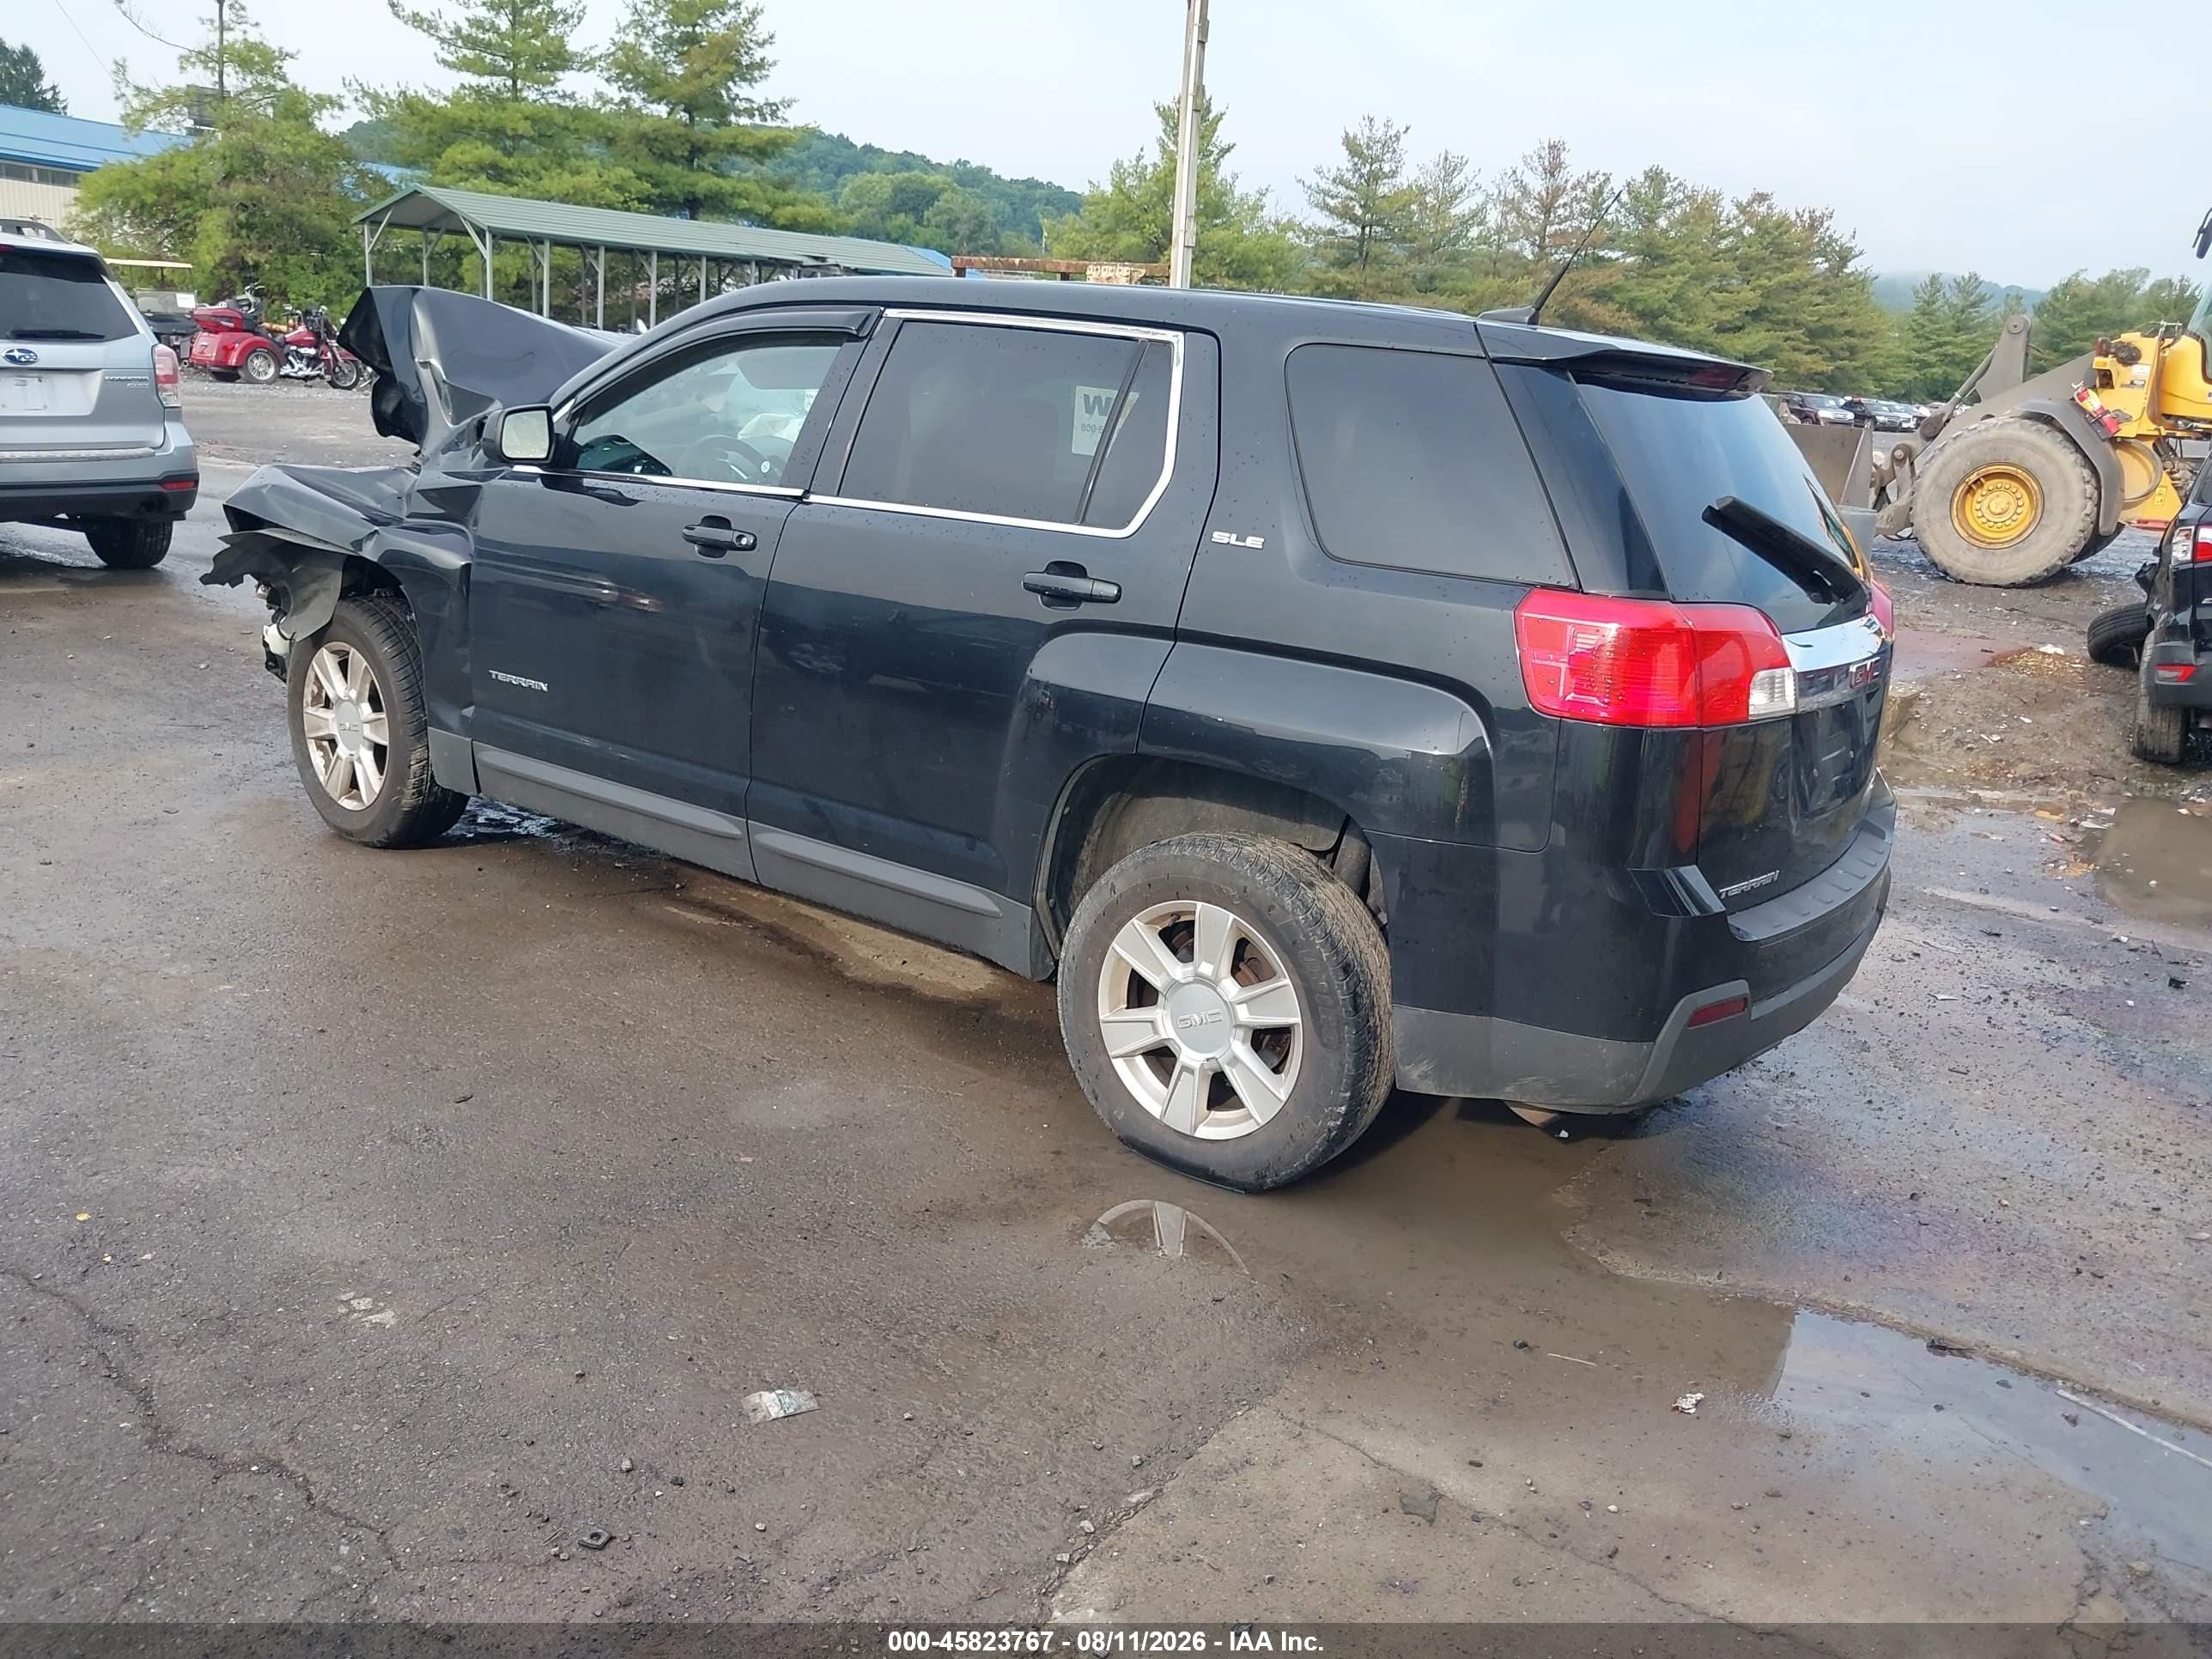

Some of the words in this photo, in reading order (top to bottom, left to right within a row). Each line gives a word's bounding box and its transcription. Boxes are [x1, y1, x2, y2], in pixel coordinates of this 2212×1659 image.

[1211, 531, 1265, 550] SLE
[489, 670, 548, 692] TERRAIN
[1719, 870, 1779, 900] TERRAIN
[1177, 1009, 1223, 1029] GMC
